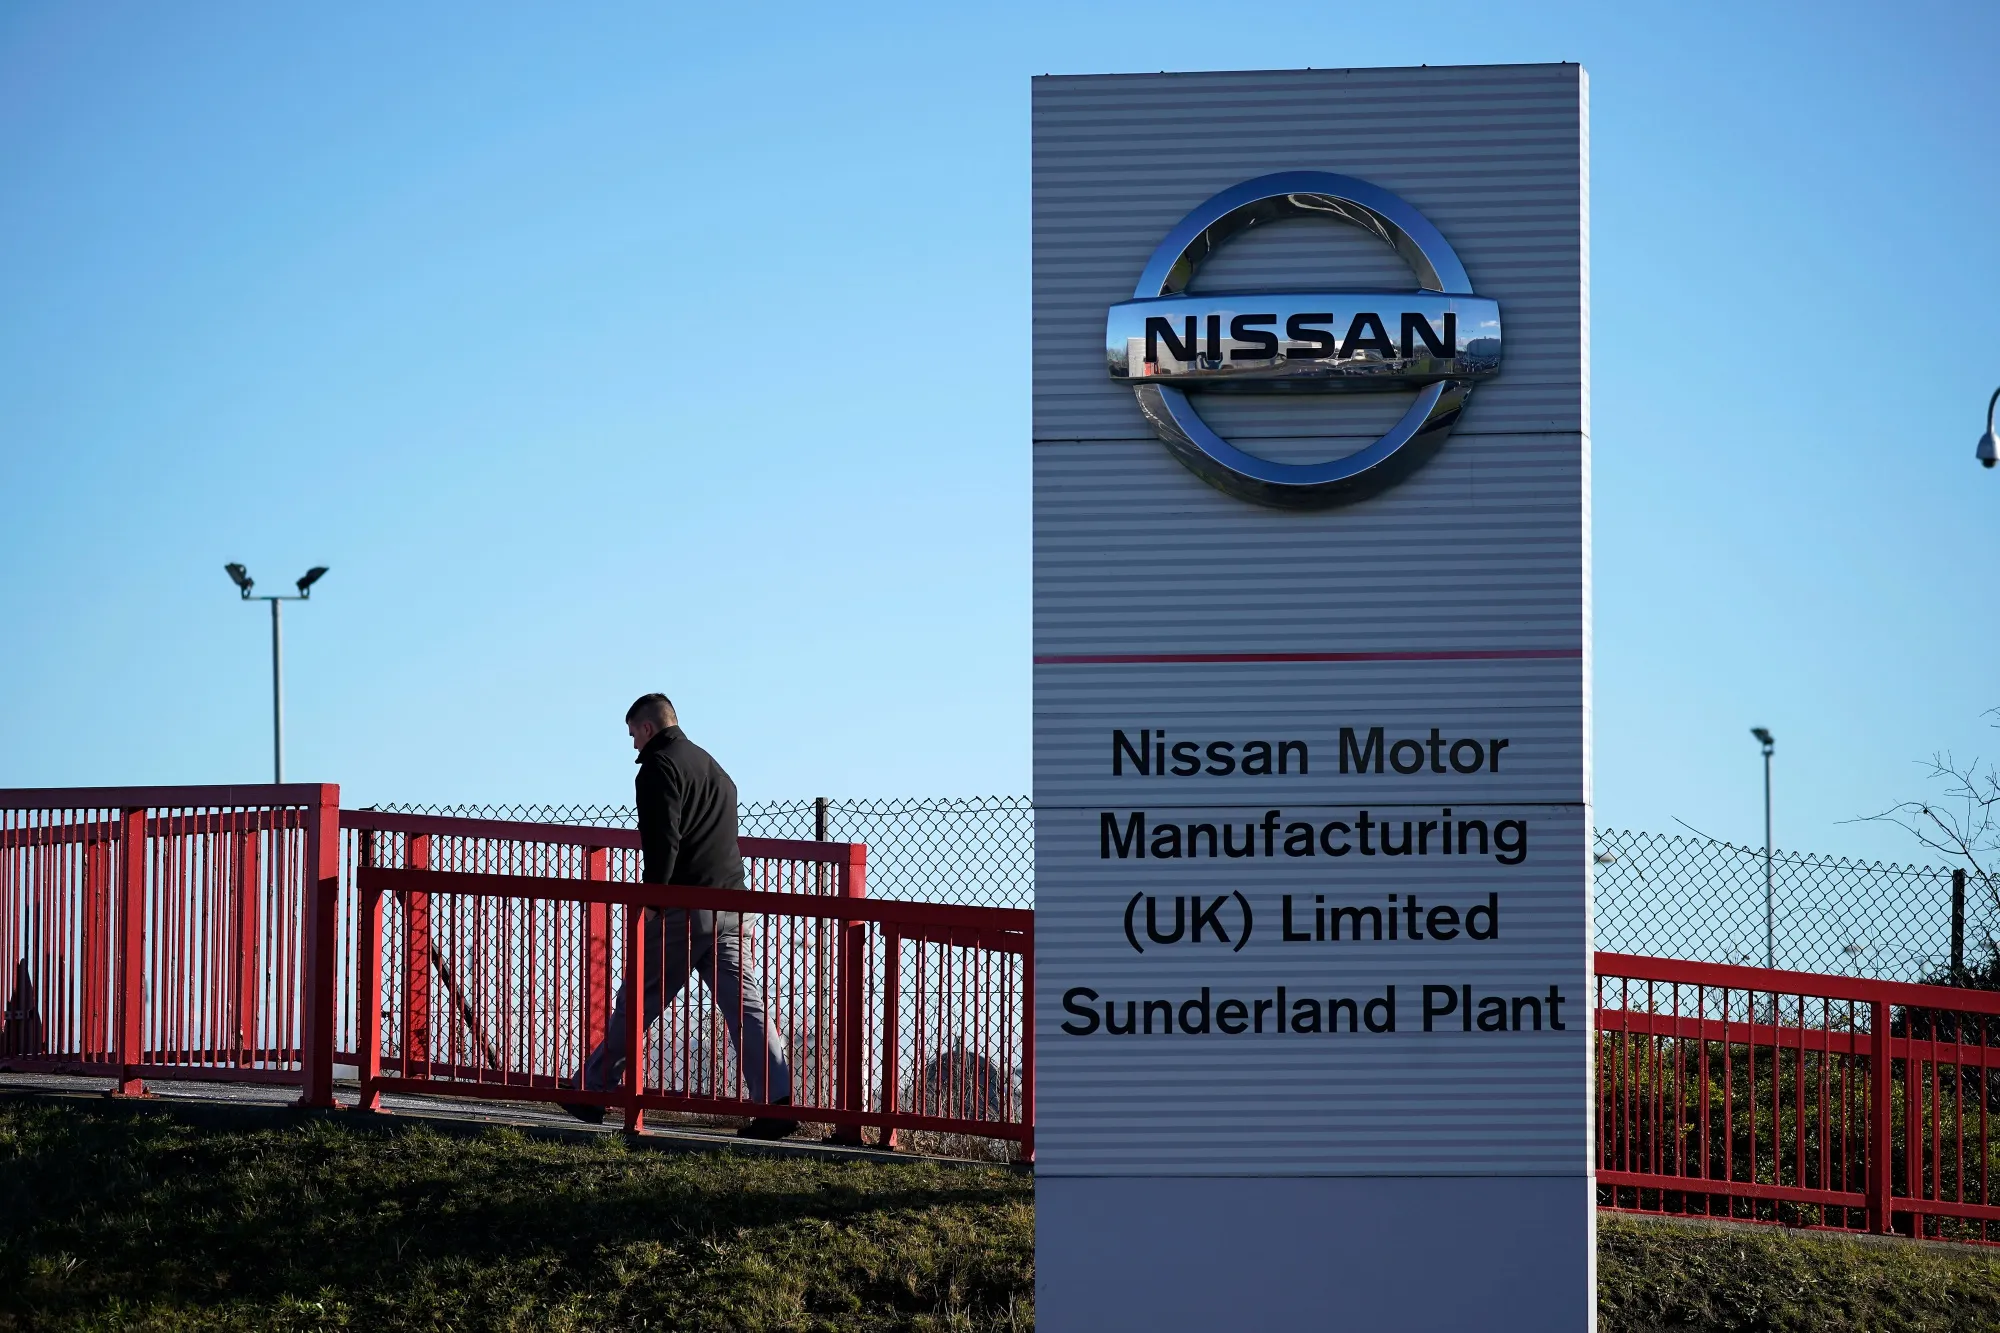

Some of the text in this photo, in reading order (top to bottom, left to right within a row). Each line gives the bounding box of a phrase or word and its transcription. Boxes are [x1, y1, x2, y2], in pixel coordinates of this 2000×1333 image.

[1145, 312, 1456, 362] NISSAN
[1112, 726, 1509, 777] Nissan Motor
[1100, 808, 1527, 865] Manufacturing
[1123, 890, 1499, 954] (UK) Limited
[1060, 984, 1566, 1036] Sunderland Plant
